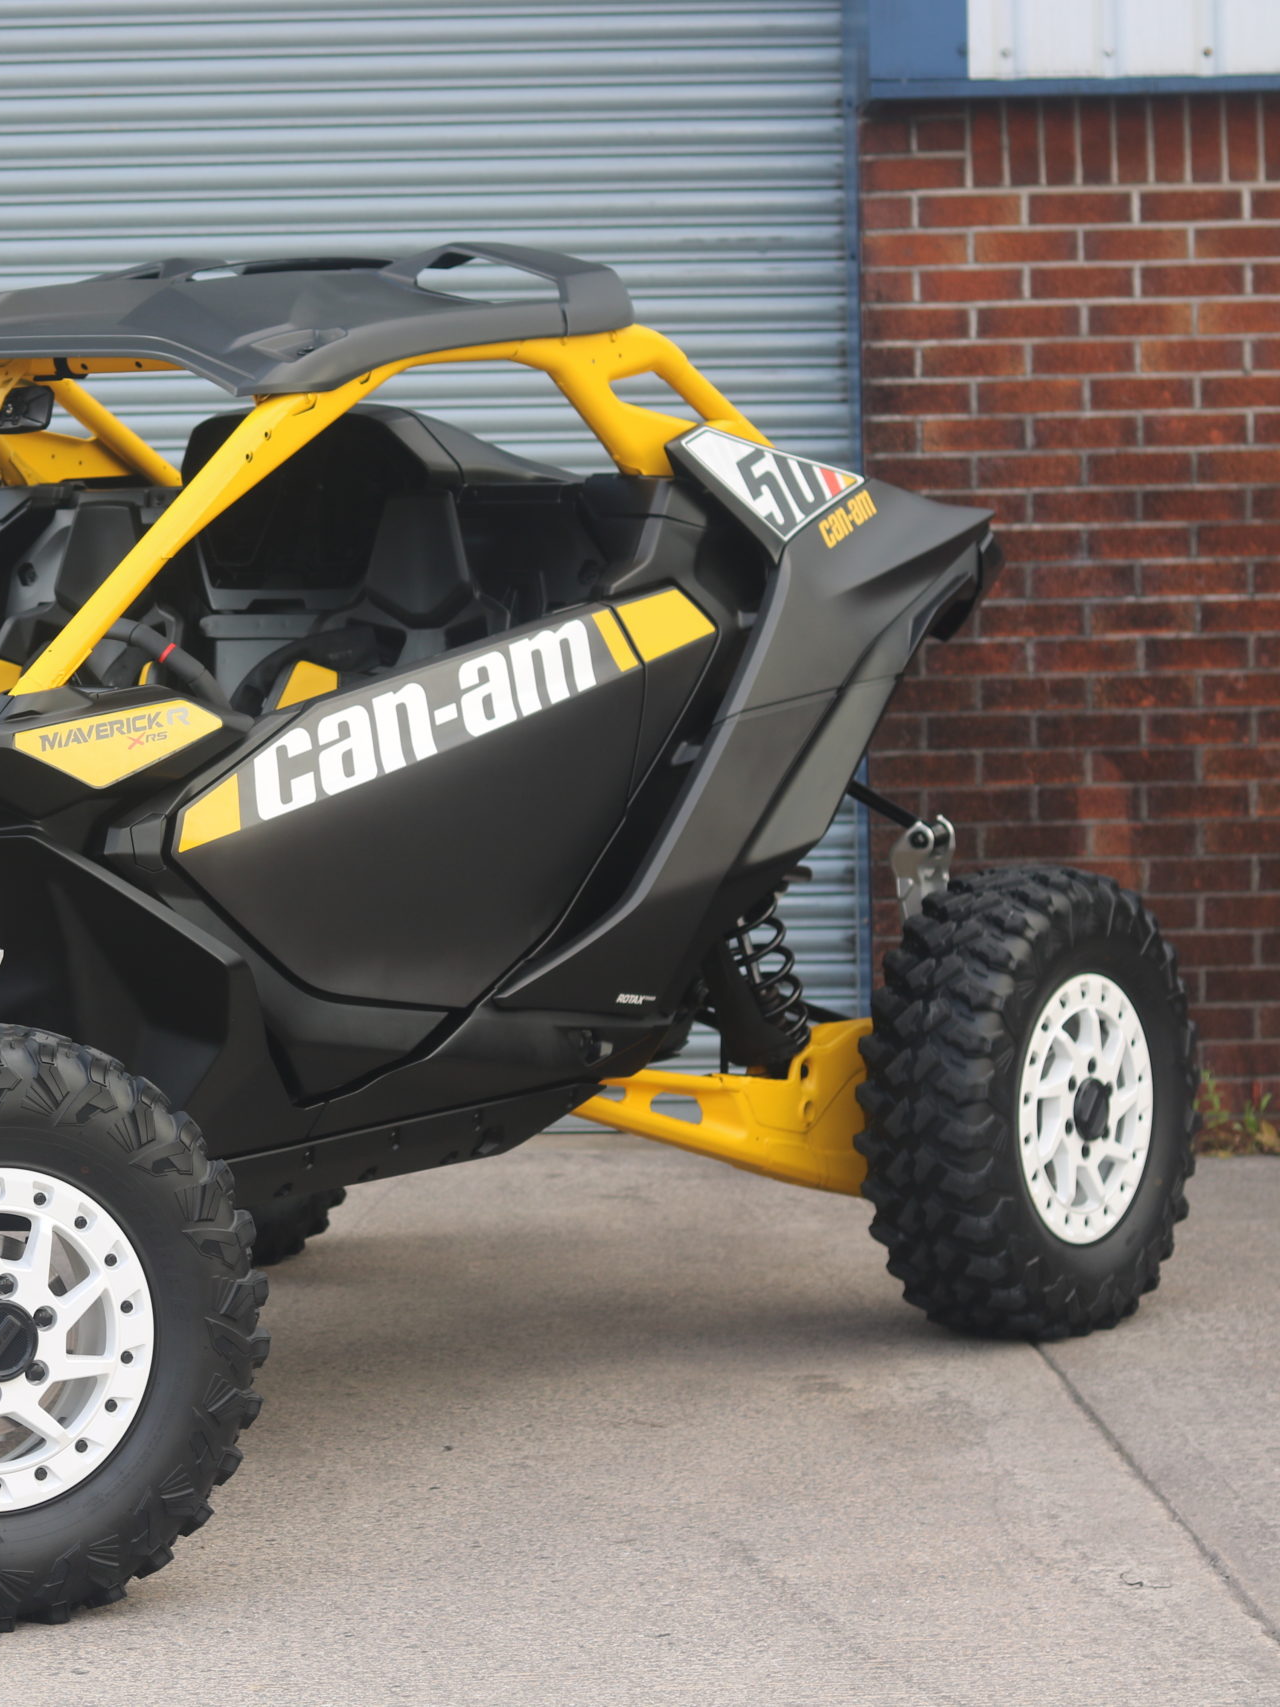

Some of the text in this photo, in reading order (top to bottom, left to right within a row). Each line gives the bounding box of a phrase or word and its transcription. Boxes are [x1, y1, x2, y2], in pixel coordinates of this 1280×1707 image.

[818, 489, 878, 549] can-am
[39, 711, 164, 752] MAVERICK
[253, 619, 597, 821] can-am
